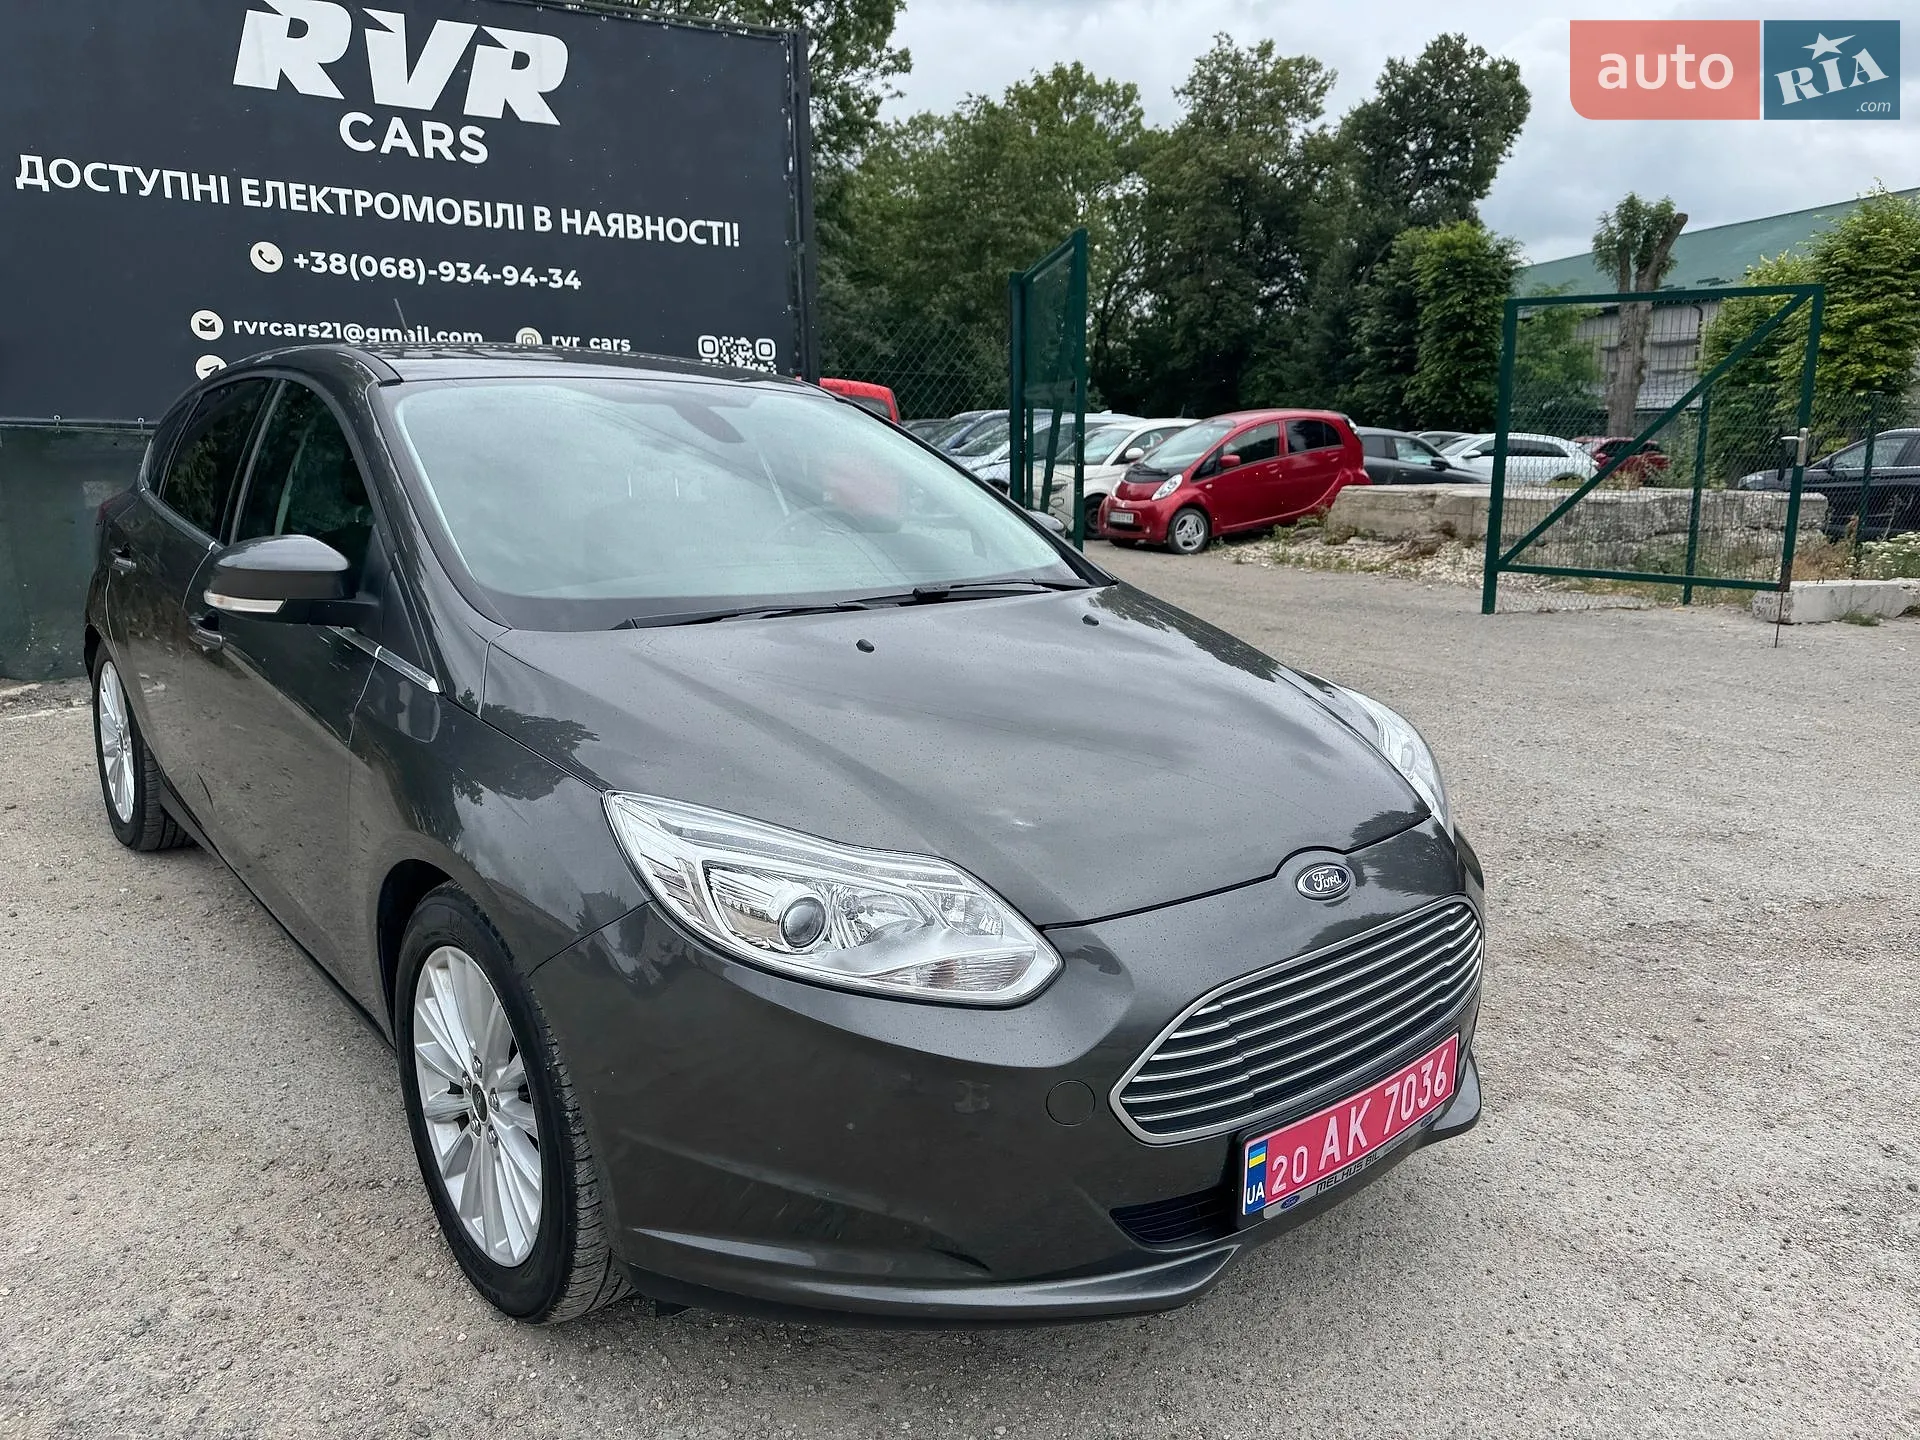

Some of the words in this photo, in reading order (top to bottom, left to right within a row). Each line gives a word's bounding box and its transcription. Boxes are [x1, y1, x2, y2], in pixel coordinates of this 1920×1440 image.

[233, 0, 569, 126] RVR
[339, 111, 489, 164] CARS
[15, 154, 230, 205] ДОСТУПНІ
[241, 177, 525, 232] ЕЛЕКТРОМОБІЛІ
[533, 205, 553, 232] В
[560, 207, 740, 247] НАЯВНОСТІ!
[293, 251, 583, 291] +38(068)-934-94-34
[233, 319, 484, 344] rvrcars21@gmail.com
[1312, 869, 1341, 891] Ford
[1246, 1182, 1265, 1205] UA
[1271, 1146, 1308, 1195] 20
[1318, 1098, 1372, 1171] AK
[1383, 1048, 1449, 1135] 7036
